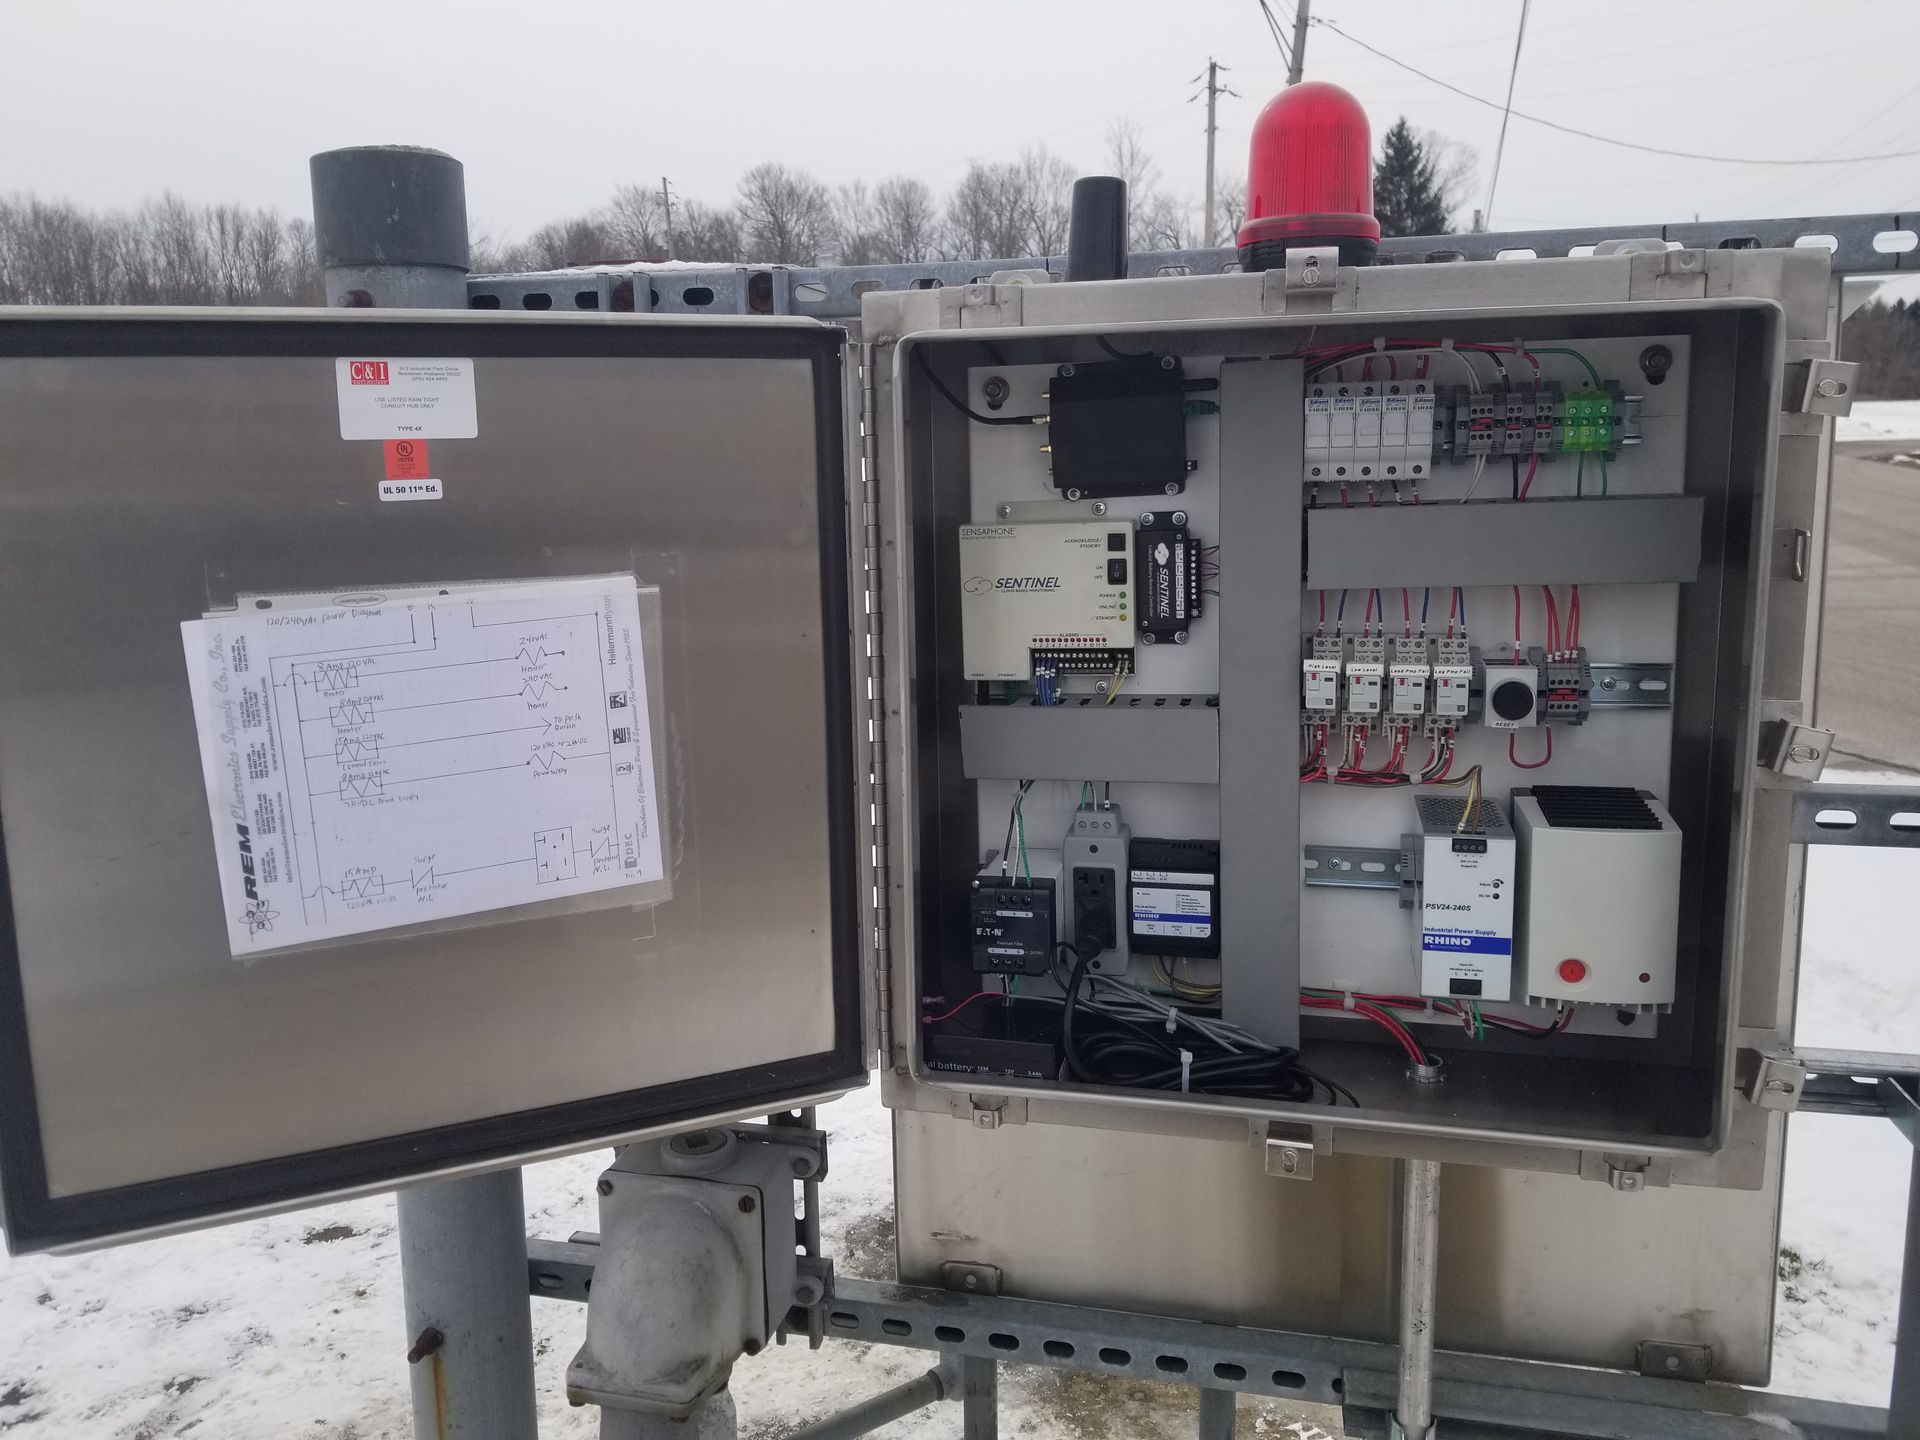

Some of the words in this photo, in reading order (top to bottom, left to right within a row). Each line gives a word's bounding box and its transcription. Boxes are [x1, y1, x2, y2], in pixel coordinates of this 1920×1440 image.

[351, 362, 386, 380] C&I
[961, 528, 1015, 536] SENSAPHONE
[995, 577, 1061, 588] SENTINEL
[1160, 567, 1169, 618] SENTINEL
[206, 632, 226, 664] Inc.
[216, 698, 241, 749] Supply
[223, 751, 247, 823] Electronics
[624, 832, 634, 858] IDEC
[236, 821, 258, 901] REM
[1425, 903, 1471, 911] PSV24-240S
[976, 928, 1002, 936] EATON
[1424, 936, 1472, 946] RHINO
[937, 1061, 972, 1072] battery
